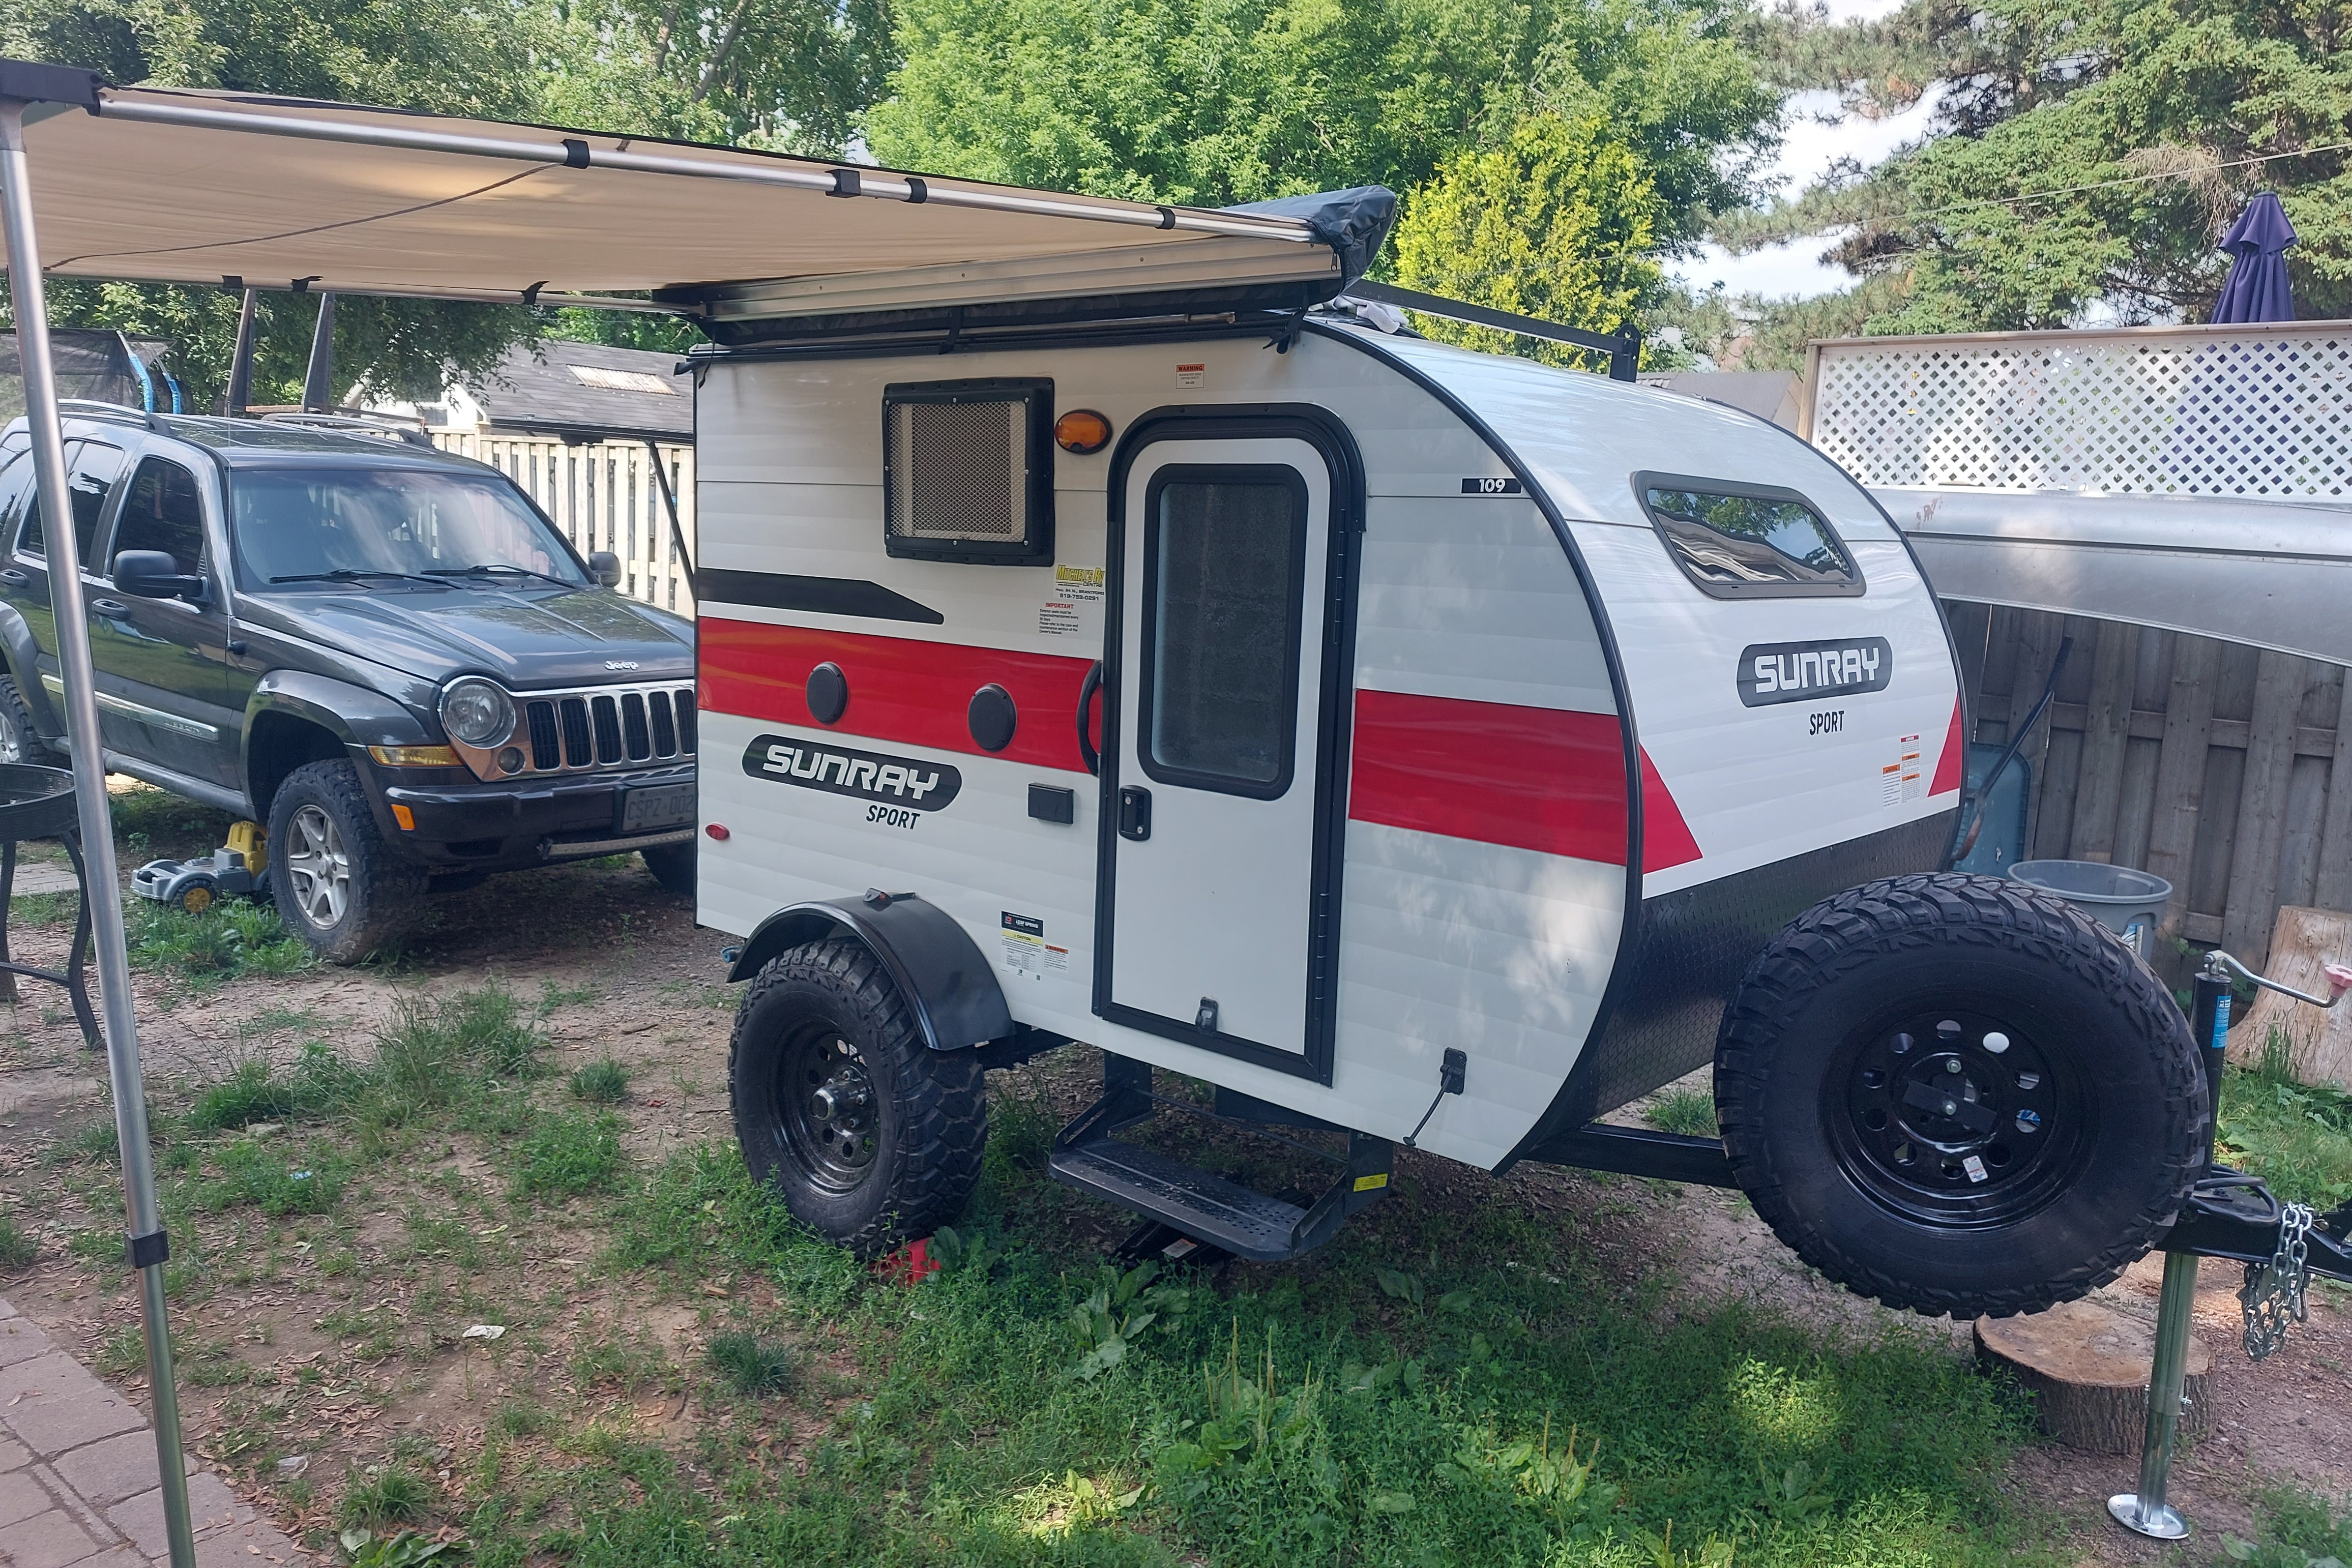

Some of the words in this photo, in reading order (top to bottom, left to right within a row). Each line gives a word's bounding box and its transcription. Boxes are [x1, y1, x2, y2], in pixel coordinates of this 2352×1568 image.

[1479, 479, 1506, 492] 109
[1055, 565, 1093, 582] MITCHELL'S
[604, 660, 639, 670] Jeep
[1754, 647, 1880, 694] SUNRAY
[1809, 710, 1845, 736] SPORT
[762, 744, 939, 800] SUNRAY
[866, 805, 921, 830] SPORT
